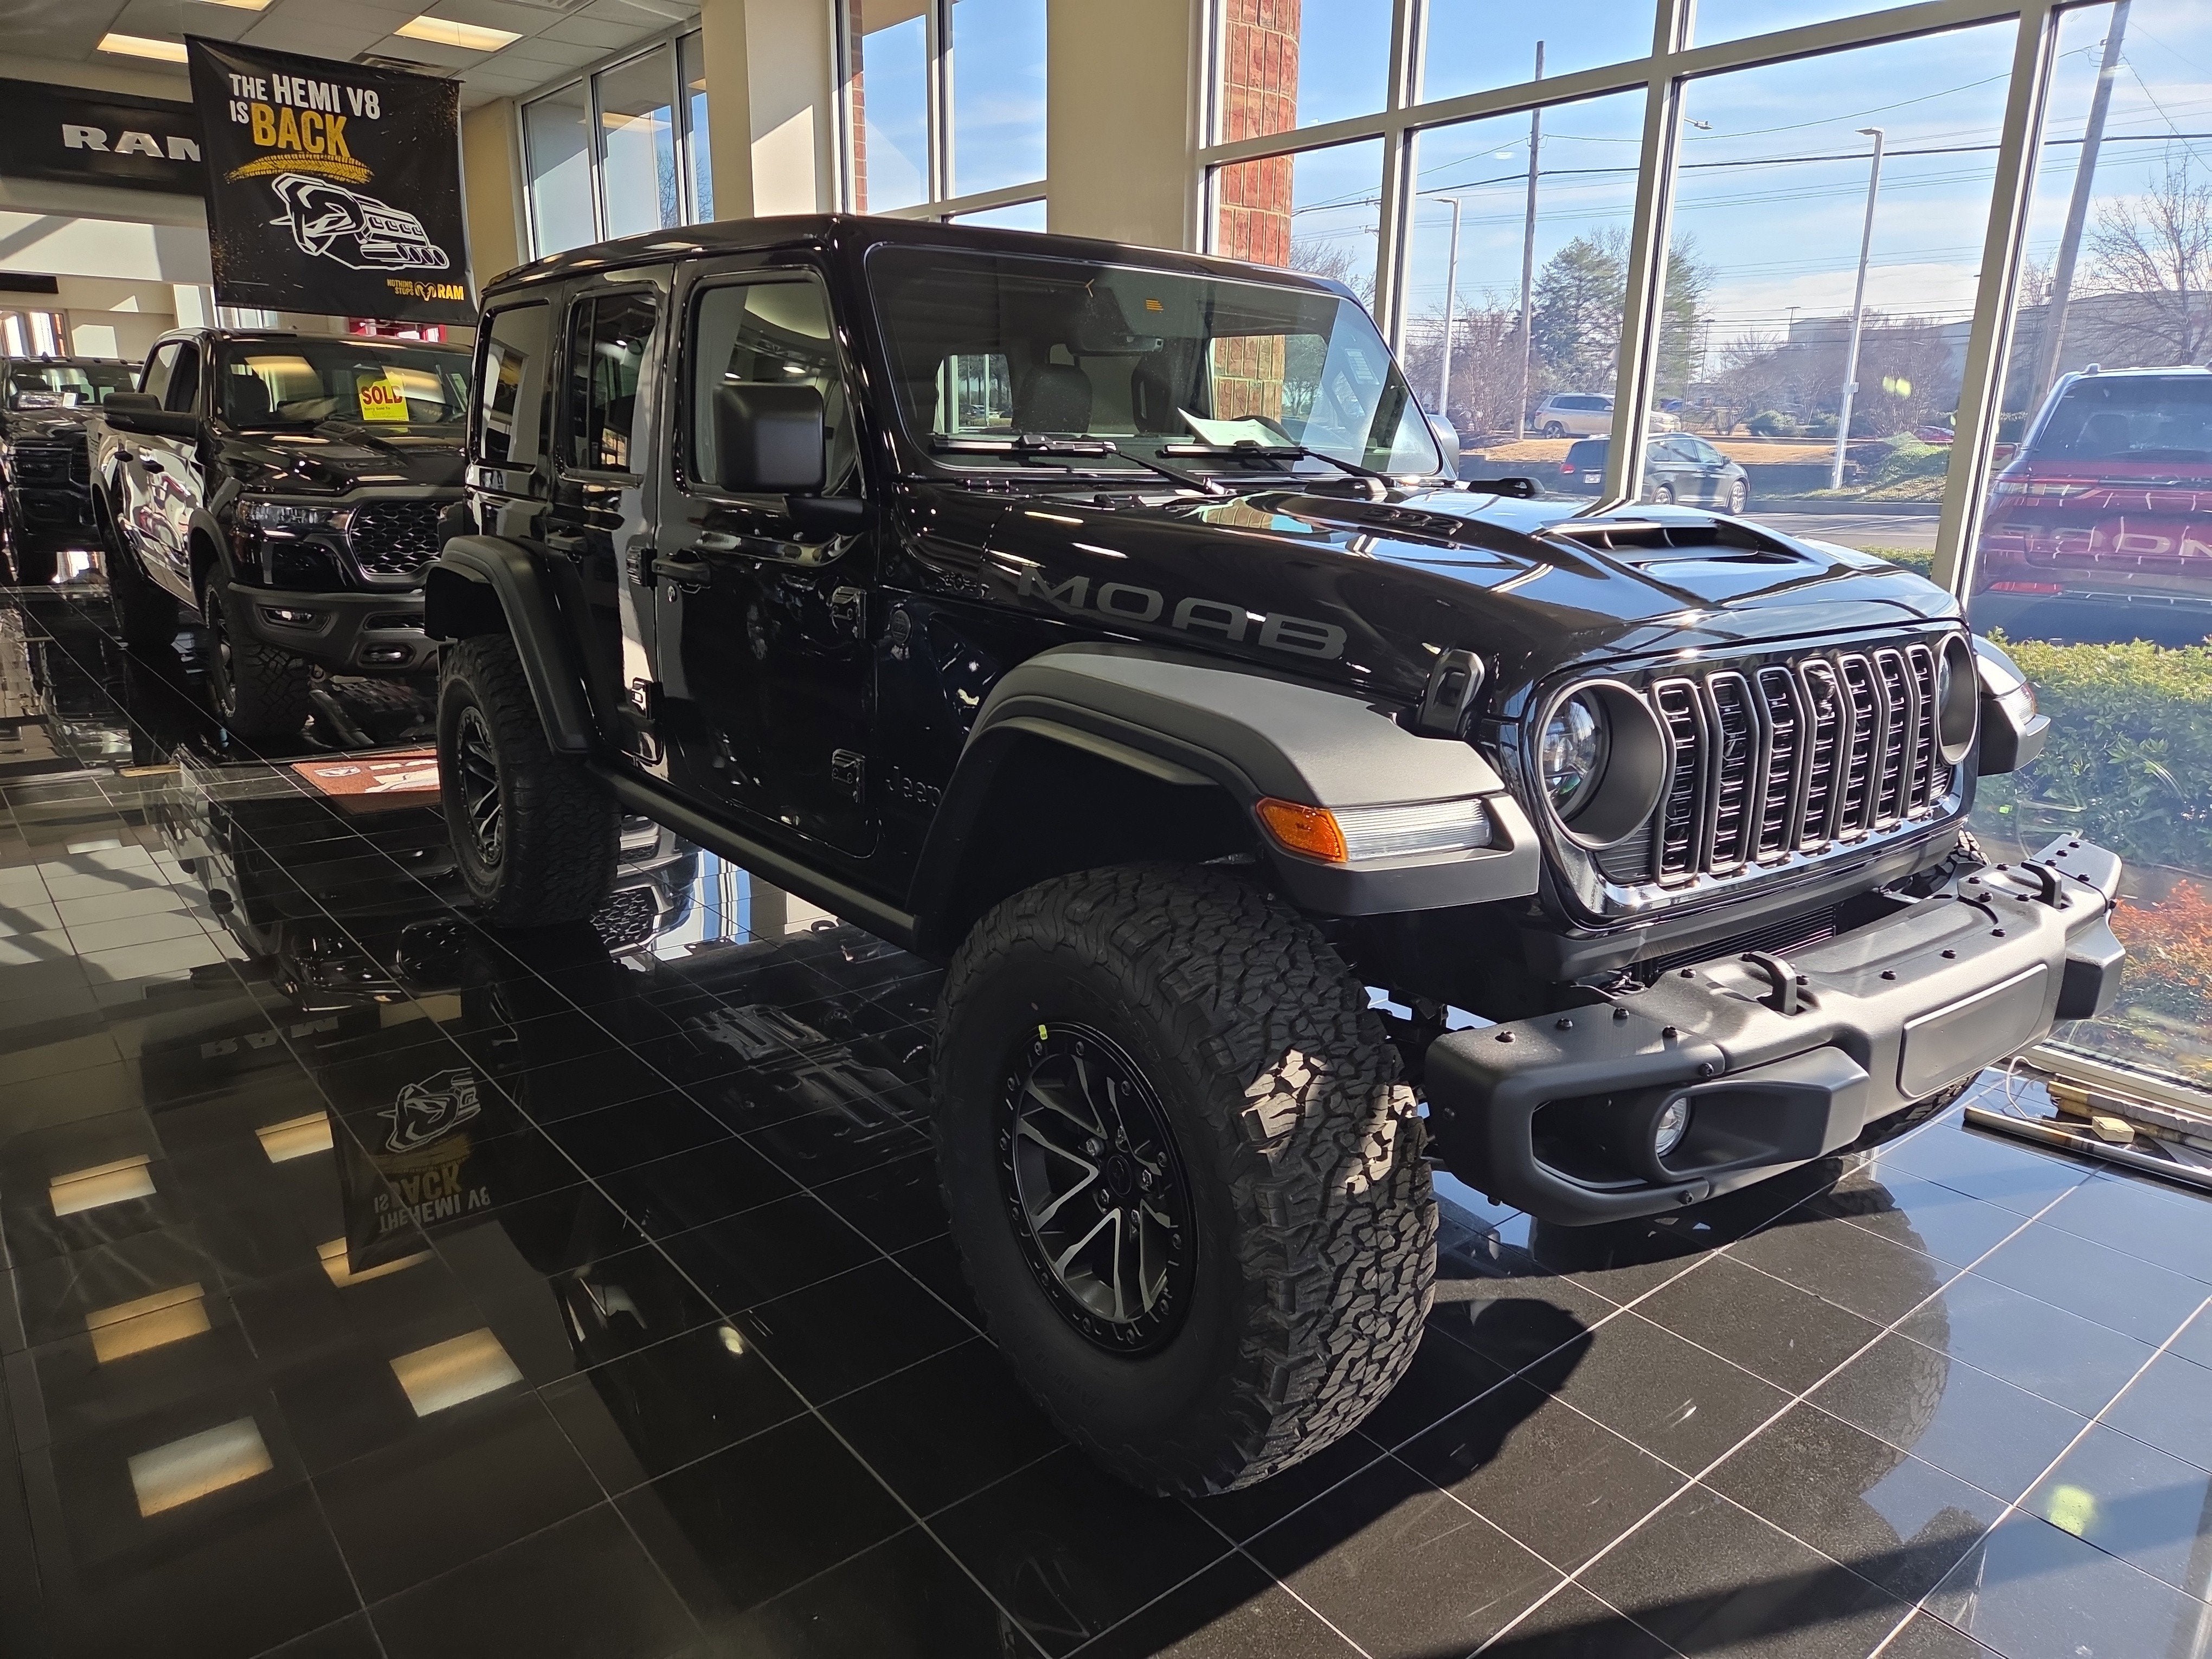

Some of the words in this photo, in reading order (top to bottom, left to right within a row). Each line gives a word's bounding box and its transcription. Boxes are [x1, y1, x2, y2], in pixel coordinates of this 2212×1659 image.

[228, 73, 268, 101] THE
[272, 74, 340, 113] HEMI
[346, 87, 381, 120] V8
[229, 100, 249, 124] IS
[250, 102, 351, 158] BACK
[387, 279, 413, 288] NOTHING
[395, 287, 414, 296] STOPS
[438, 284, 465, 300] RAM
[361, 386, 403, 405] SOLD
[1017, 565, 1348, 660] MOAB
[885, 766, 943, 807] Jeep
